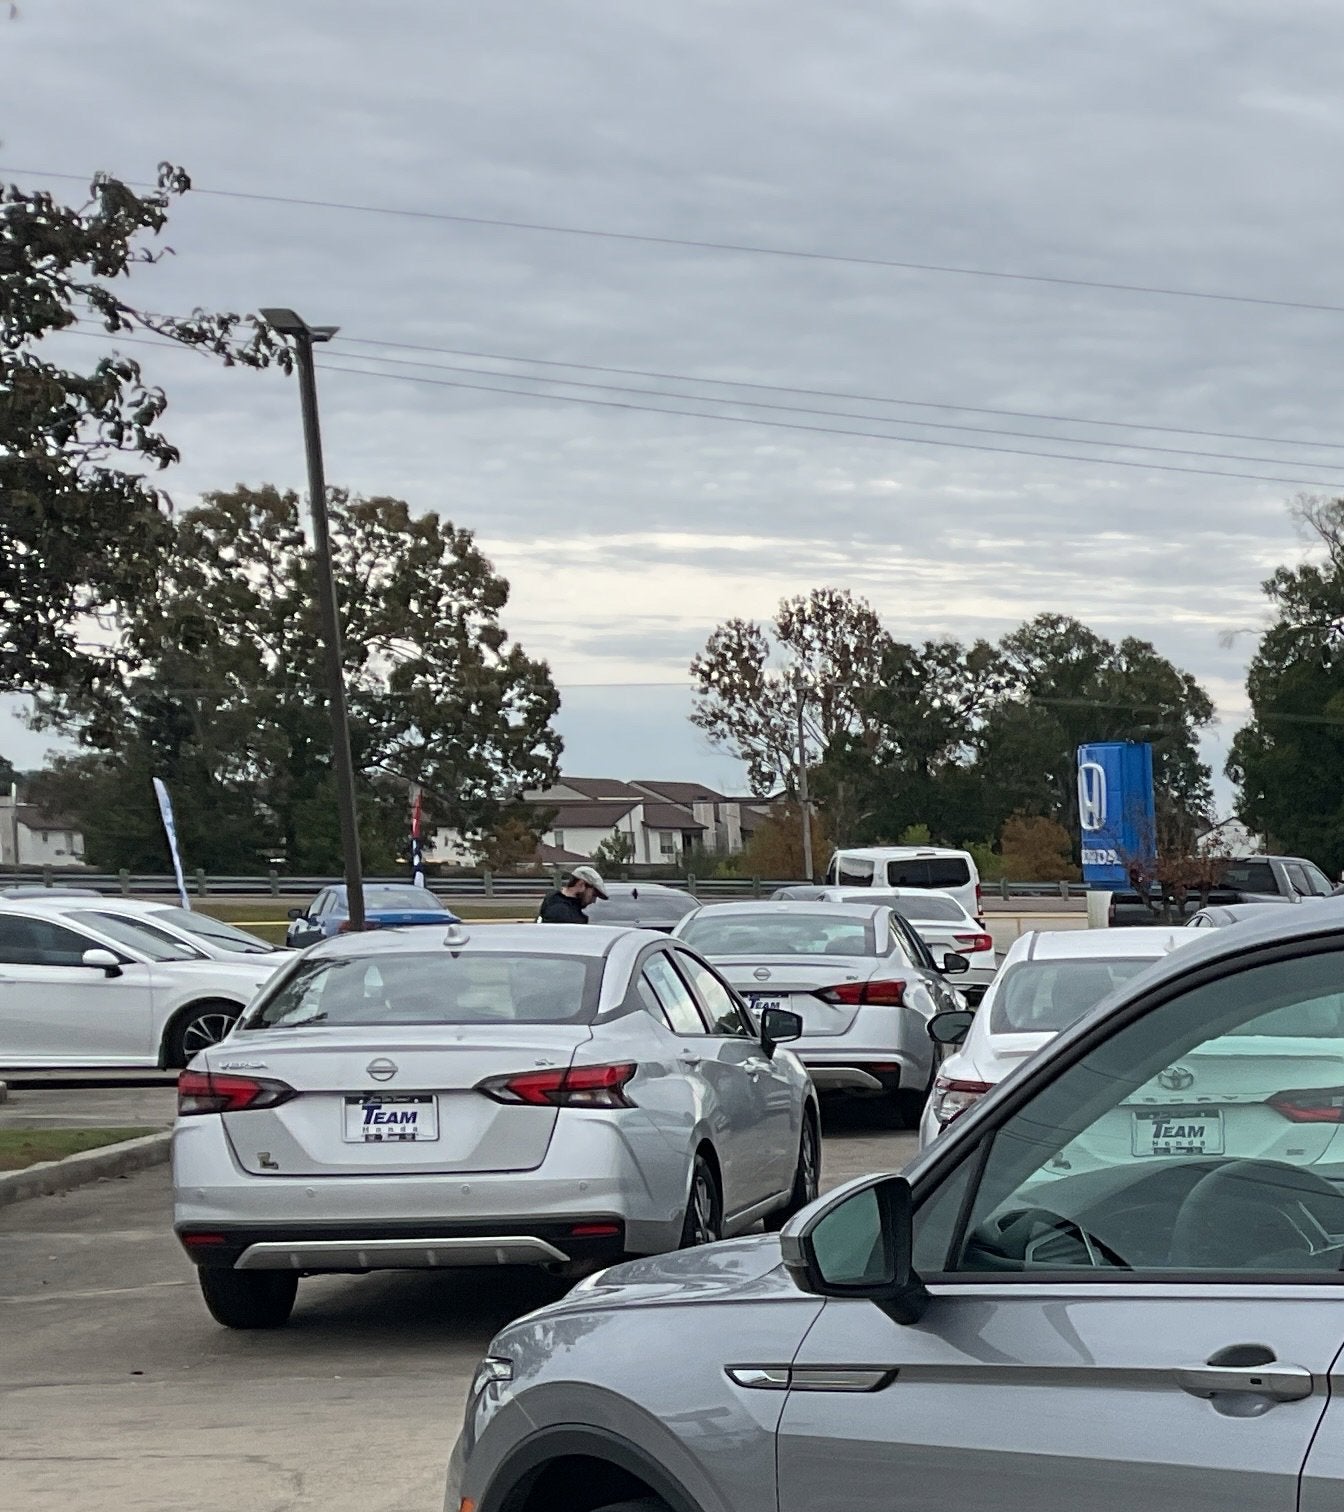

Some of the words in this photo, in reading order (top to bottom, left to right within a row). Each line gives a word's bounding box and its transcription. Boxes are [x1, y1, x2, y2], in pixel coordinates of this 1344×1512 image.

[748, 993, 780, 1010] TEAM
[361, 1104, 418, 1125] TEAM
[1152, 1119, 1206, 1139] TEAM
